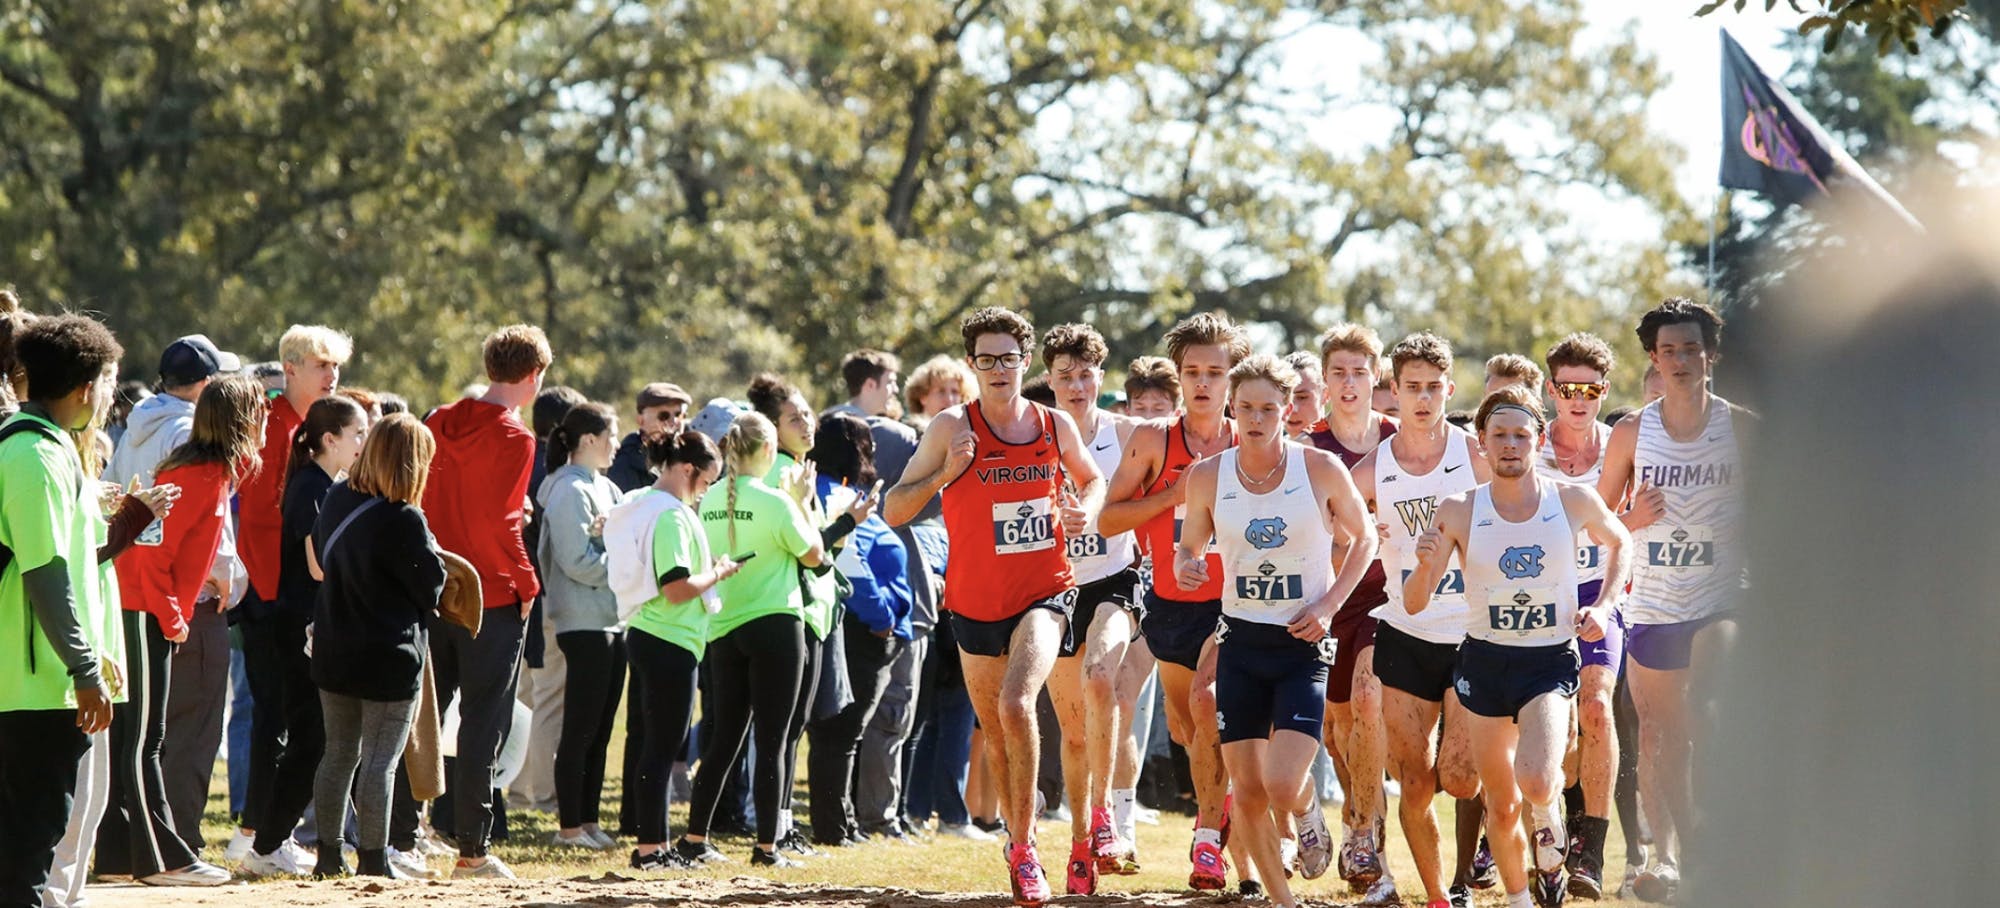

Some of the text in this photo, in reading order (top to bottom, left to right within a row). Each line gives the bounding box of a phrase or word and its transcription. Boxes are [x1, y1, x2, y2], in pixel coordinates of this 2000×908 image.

[1641, 464, 1733, 487] FURMAN
[702, 510, 753, 521] VOLUNEER
[1003, 515, 1048, 545] 640
[1065, 533, 1099, 557] 68
[1656, 542, 1705, 567] 472
[1246, 575, 1290, 600] 571
[1498, 604, 1548, 630] 573
